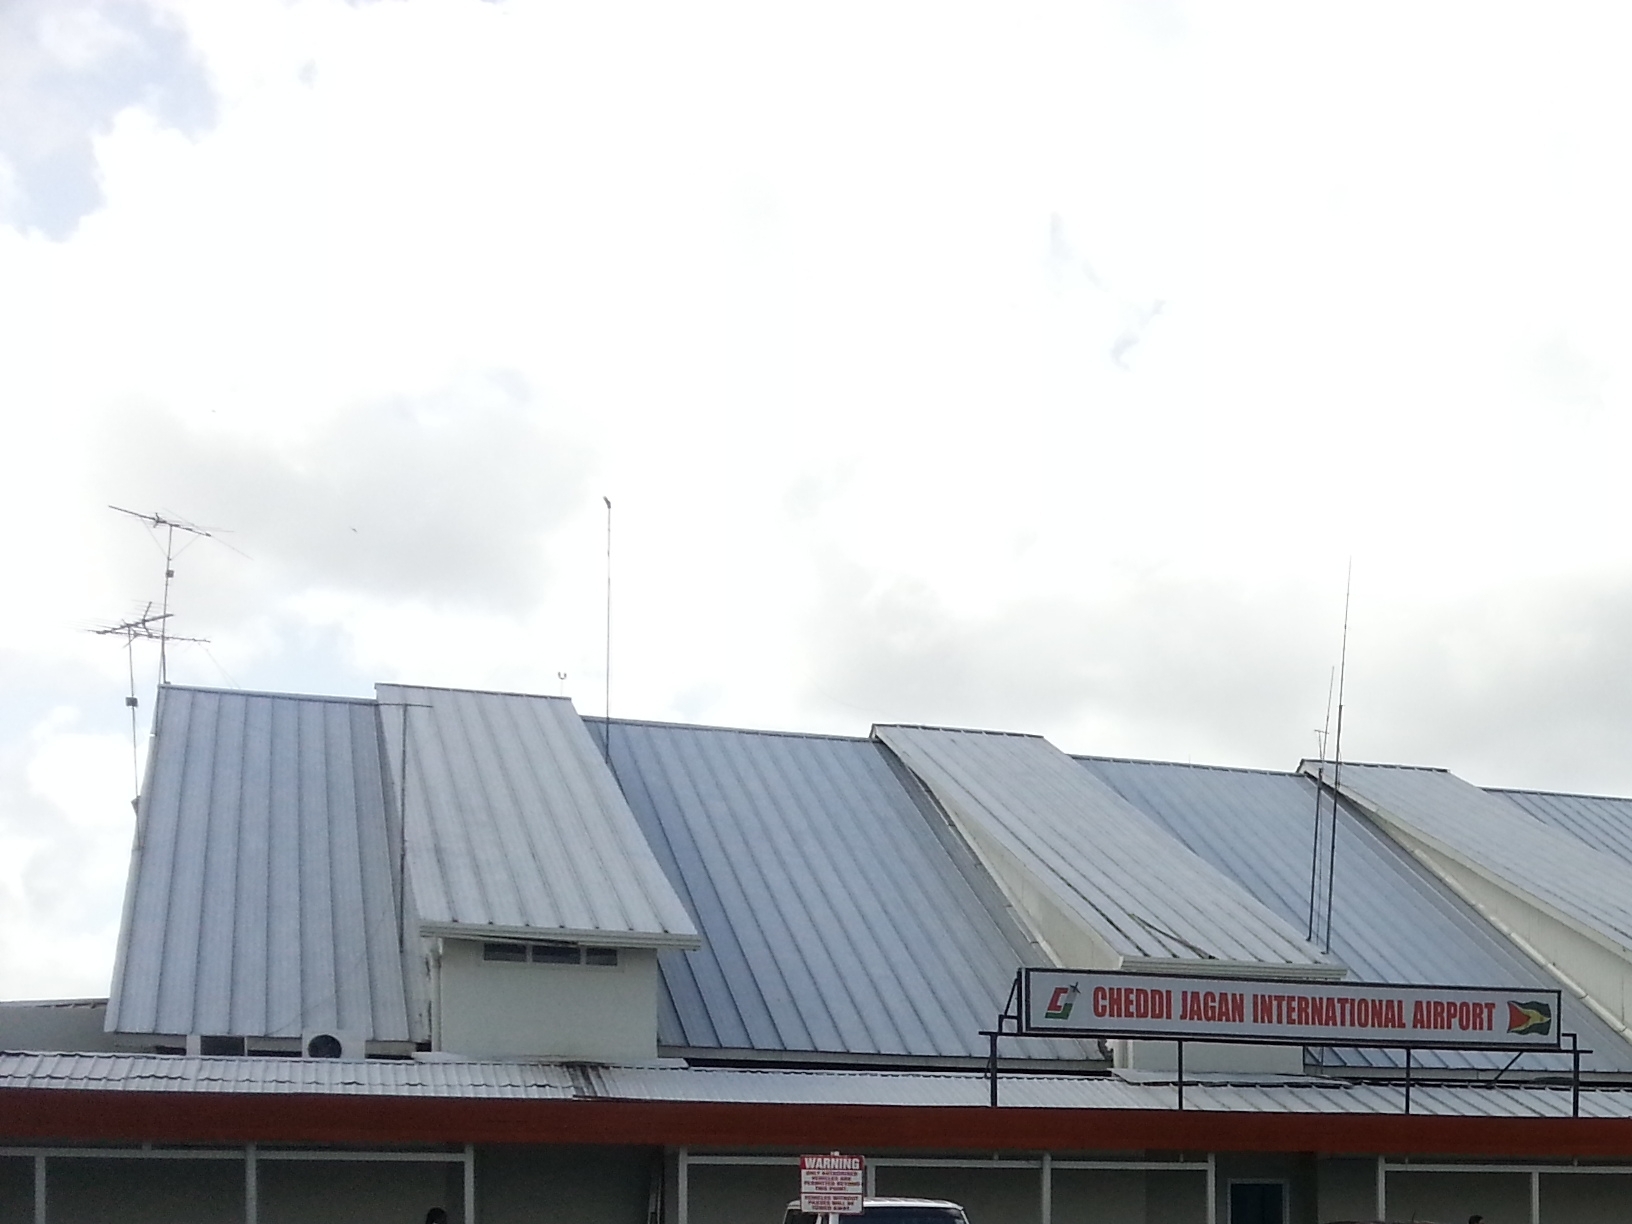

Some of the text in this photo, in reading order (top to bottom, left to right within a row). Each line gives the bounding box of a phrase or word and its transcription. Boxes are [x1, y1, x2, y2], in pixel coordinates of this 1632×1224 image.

[1093, 986, 1496, 1031] CHEDDI JAGAN INTERNATIONAL AIRPORT
[804, 1157, 860, 1170] WARNING
